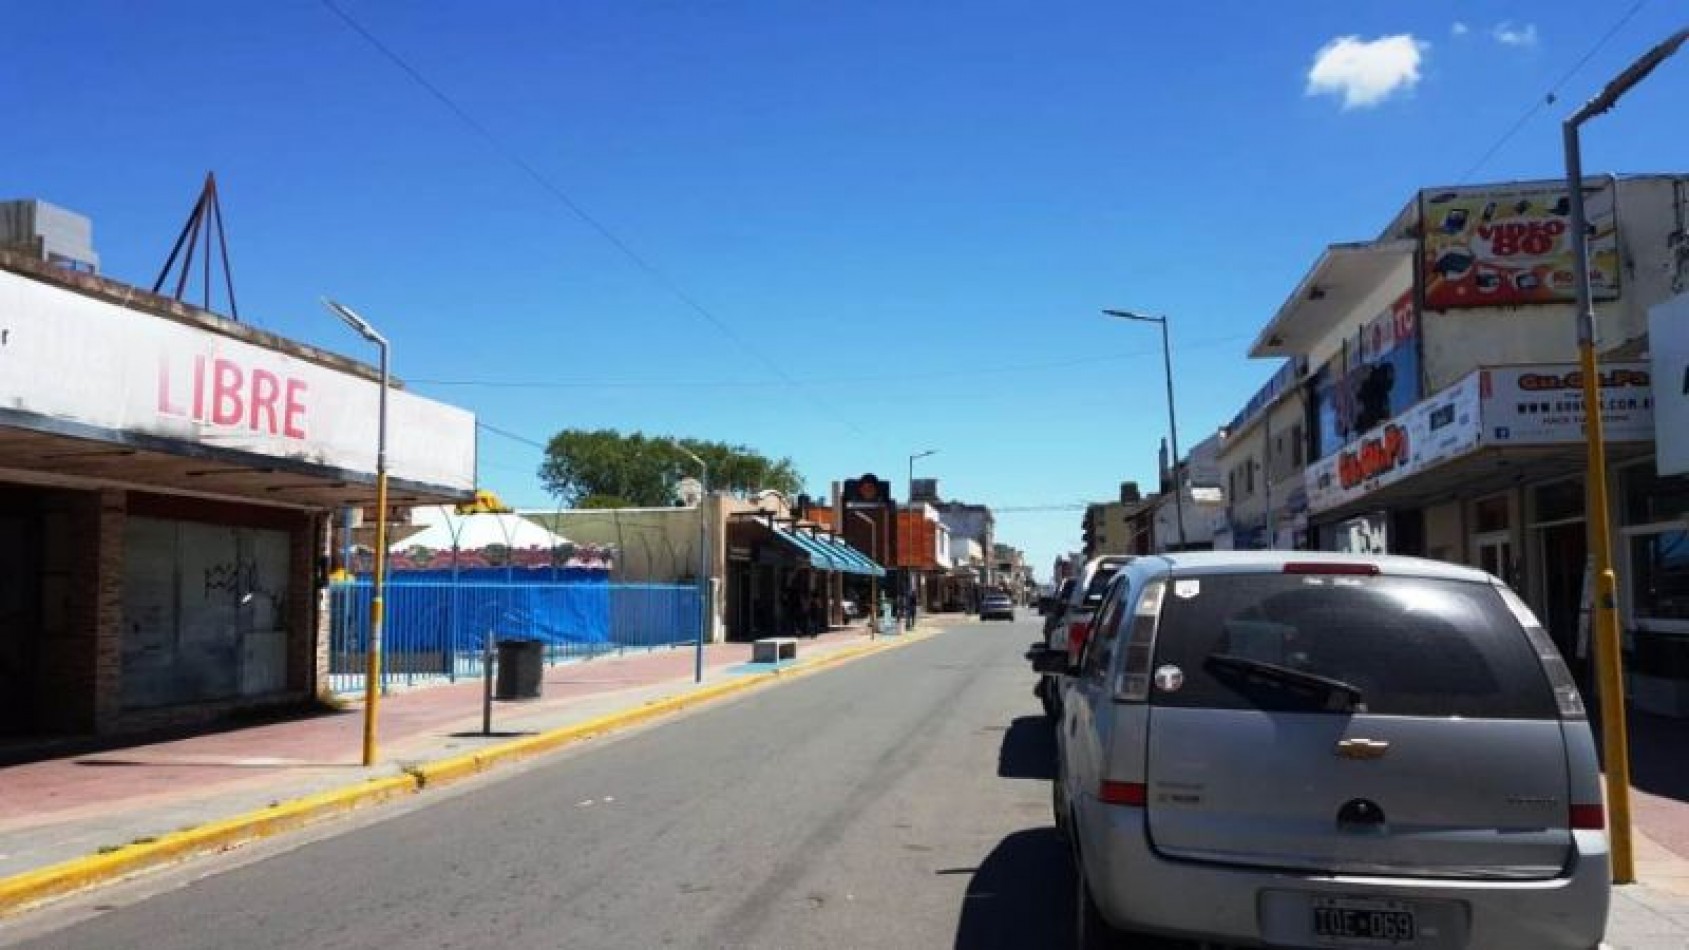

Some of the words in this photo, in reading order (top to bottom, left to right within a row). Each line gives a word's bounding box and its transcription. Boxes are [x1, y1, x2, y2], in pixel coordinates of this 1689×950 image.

[1477, 219, 1566, 240] VIDEO
[1492, 234, 1553, 256] 80
[157, 351, 308, 440] LIBRE
[1369, 913, 1410, 939] 069
